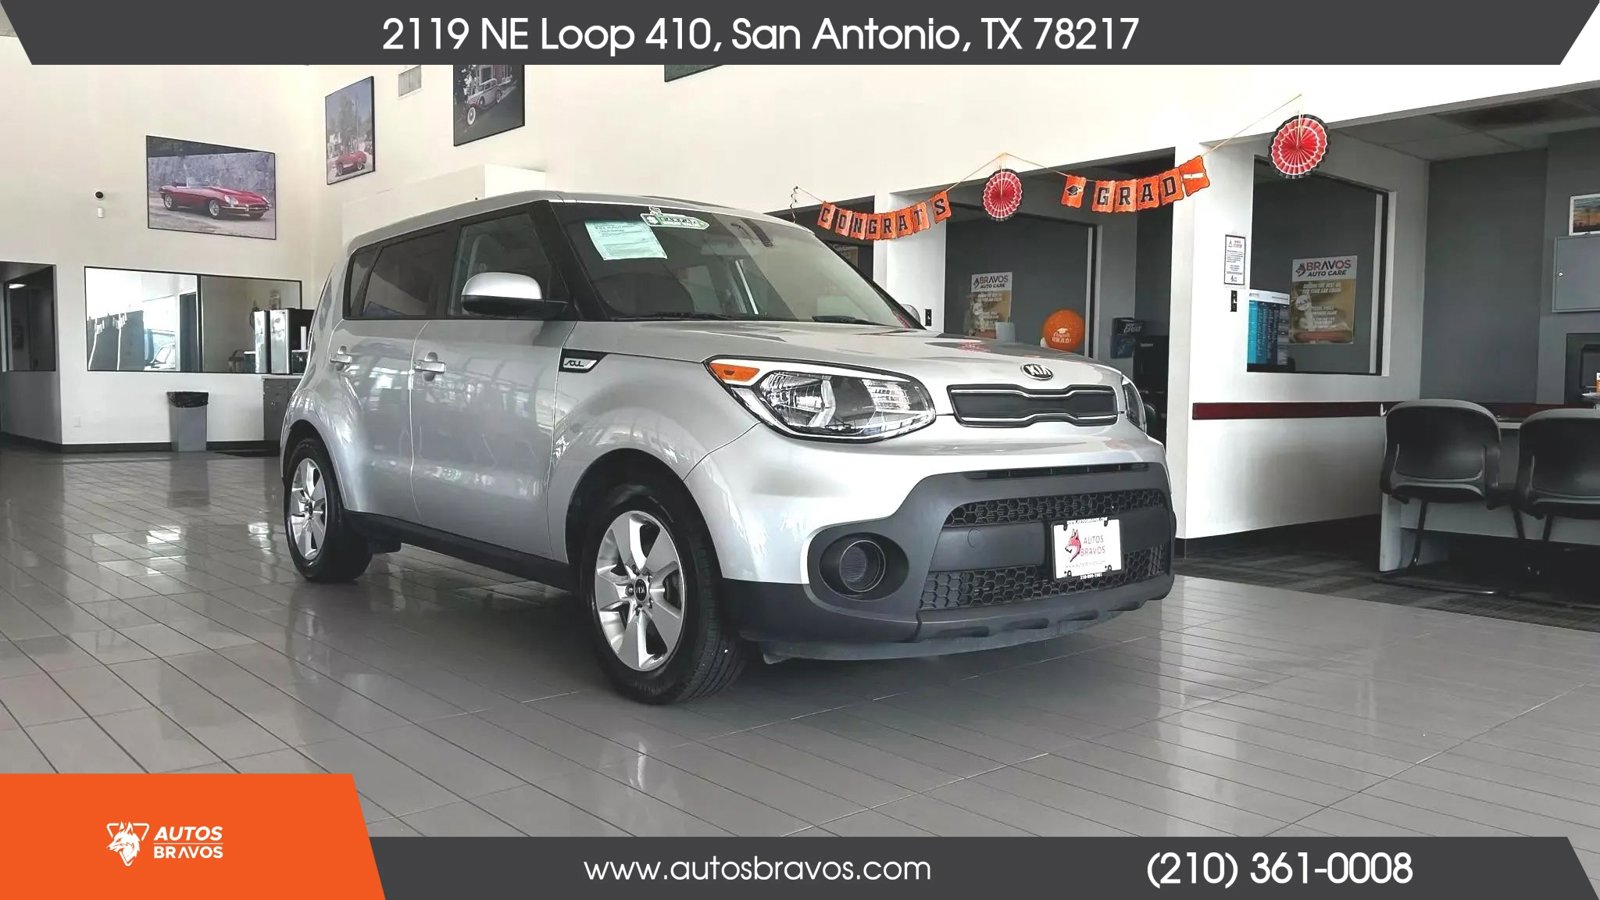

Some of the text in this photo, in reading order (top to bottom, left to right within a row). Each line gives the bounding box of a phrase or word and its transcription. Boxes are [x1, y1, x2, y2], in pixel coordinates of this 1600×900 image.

[820, 198, 946, 234] CONGRATS
[1306, 259, 1352, 272] BRAVOS
[1307, 269, 1348, 278] AUTO CARE
[979, 274, 1009, 285] BRAVOS
[1025, 364, 1052, 375] KIA
[1083, 535, 1104, 545] AUTOS
[1080, 546, 1106, 557] BRAVOS
